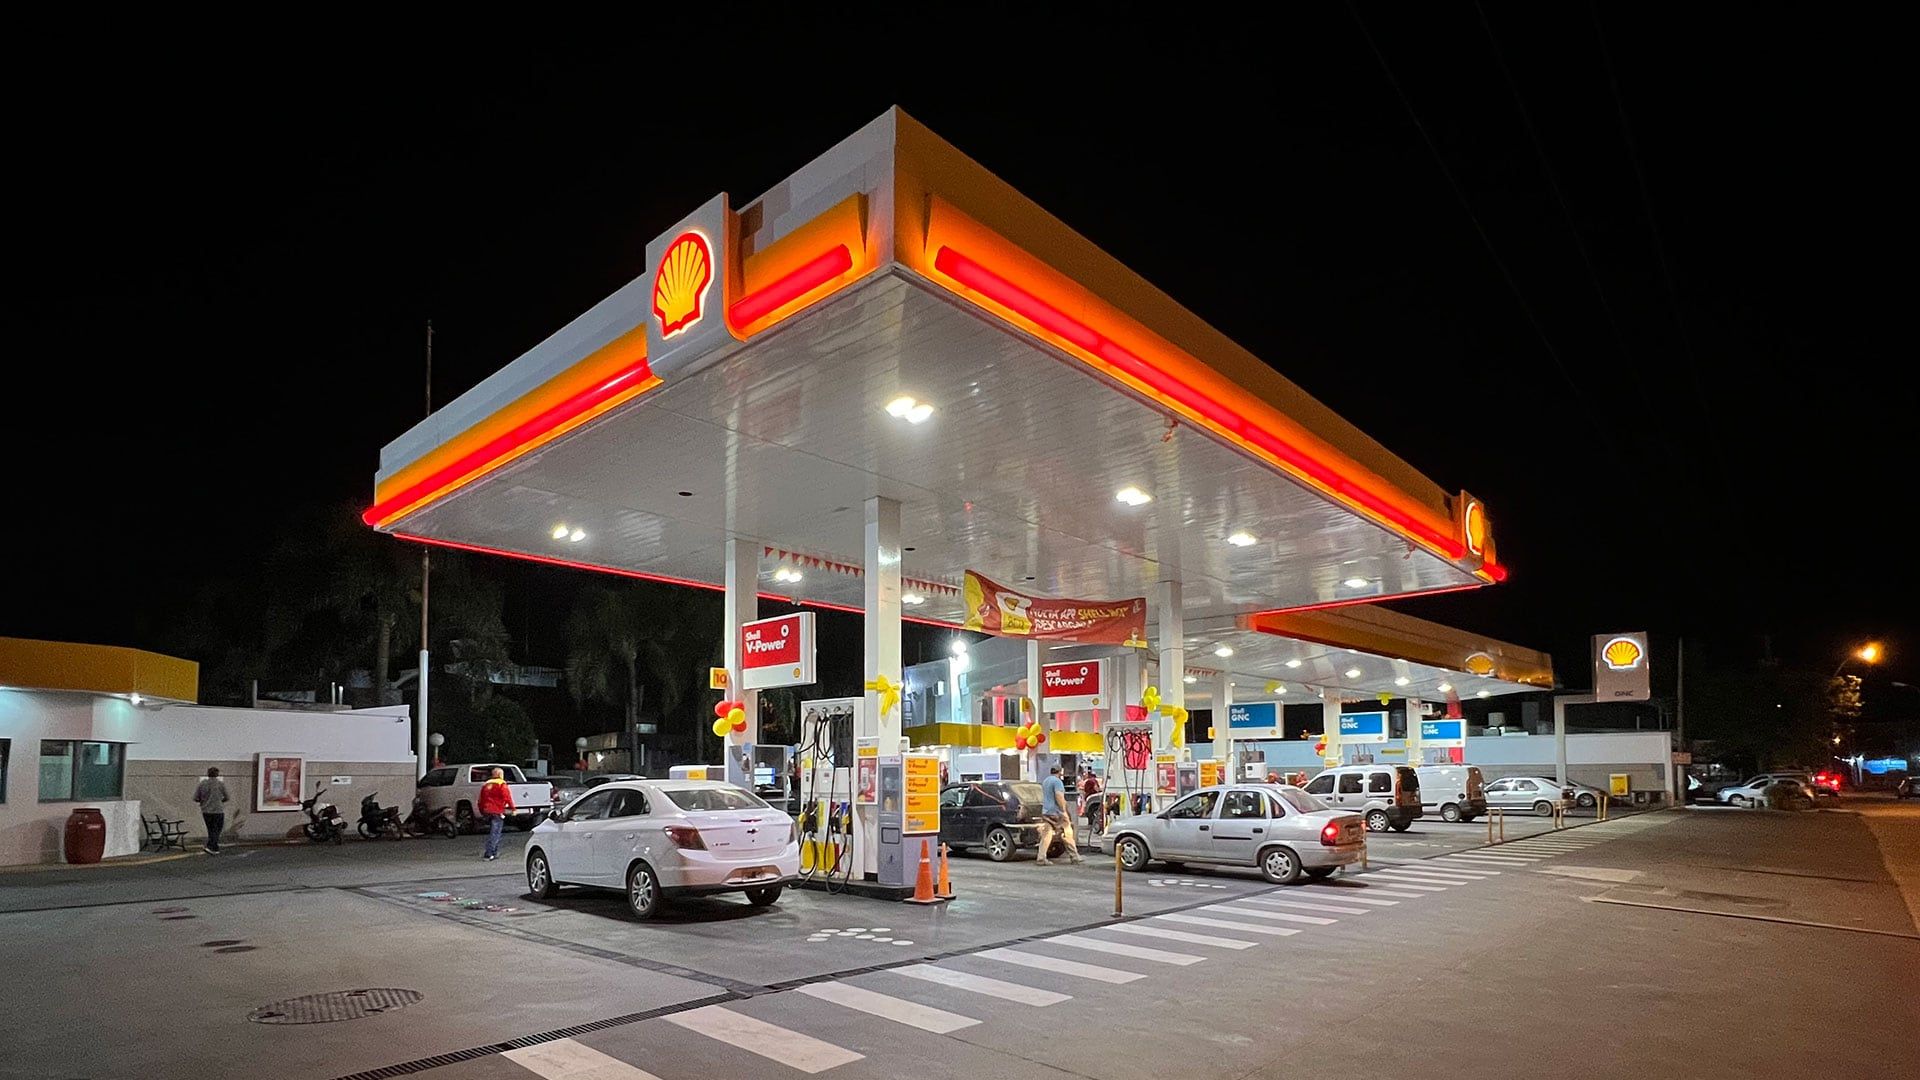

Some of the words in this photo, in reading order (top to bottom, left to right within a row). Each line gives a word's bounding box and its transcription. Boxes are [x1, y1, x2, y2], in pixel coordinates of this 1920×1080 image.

[1078, 608, 1109, 620] SHELL
[746, 630, 761, 641] Shell
[746, 640, 786, 654] V-Power
[1046, 677, 1085, 687] V-Power
[1231, 713, 1250, 722] GNC
